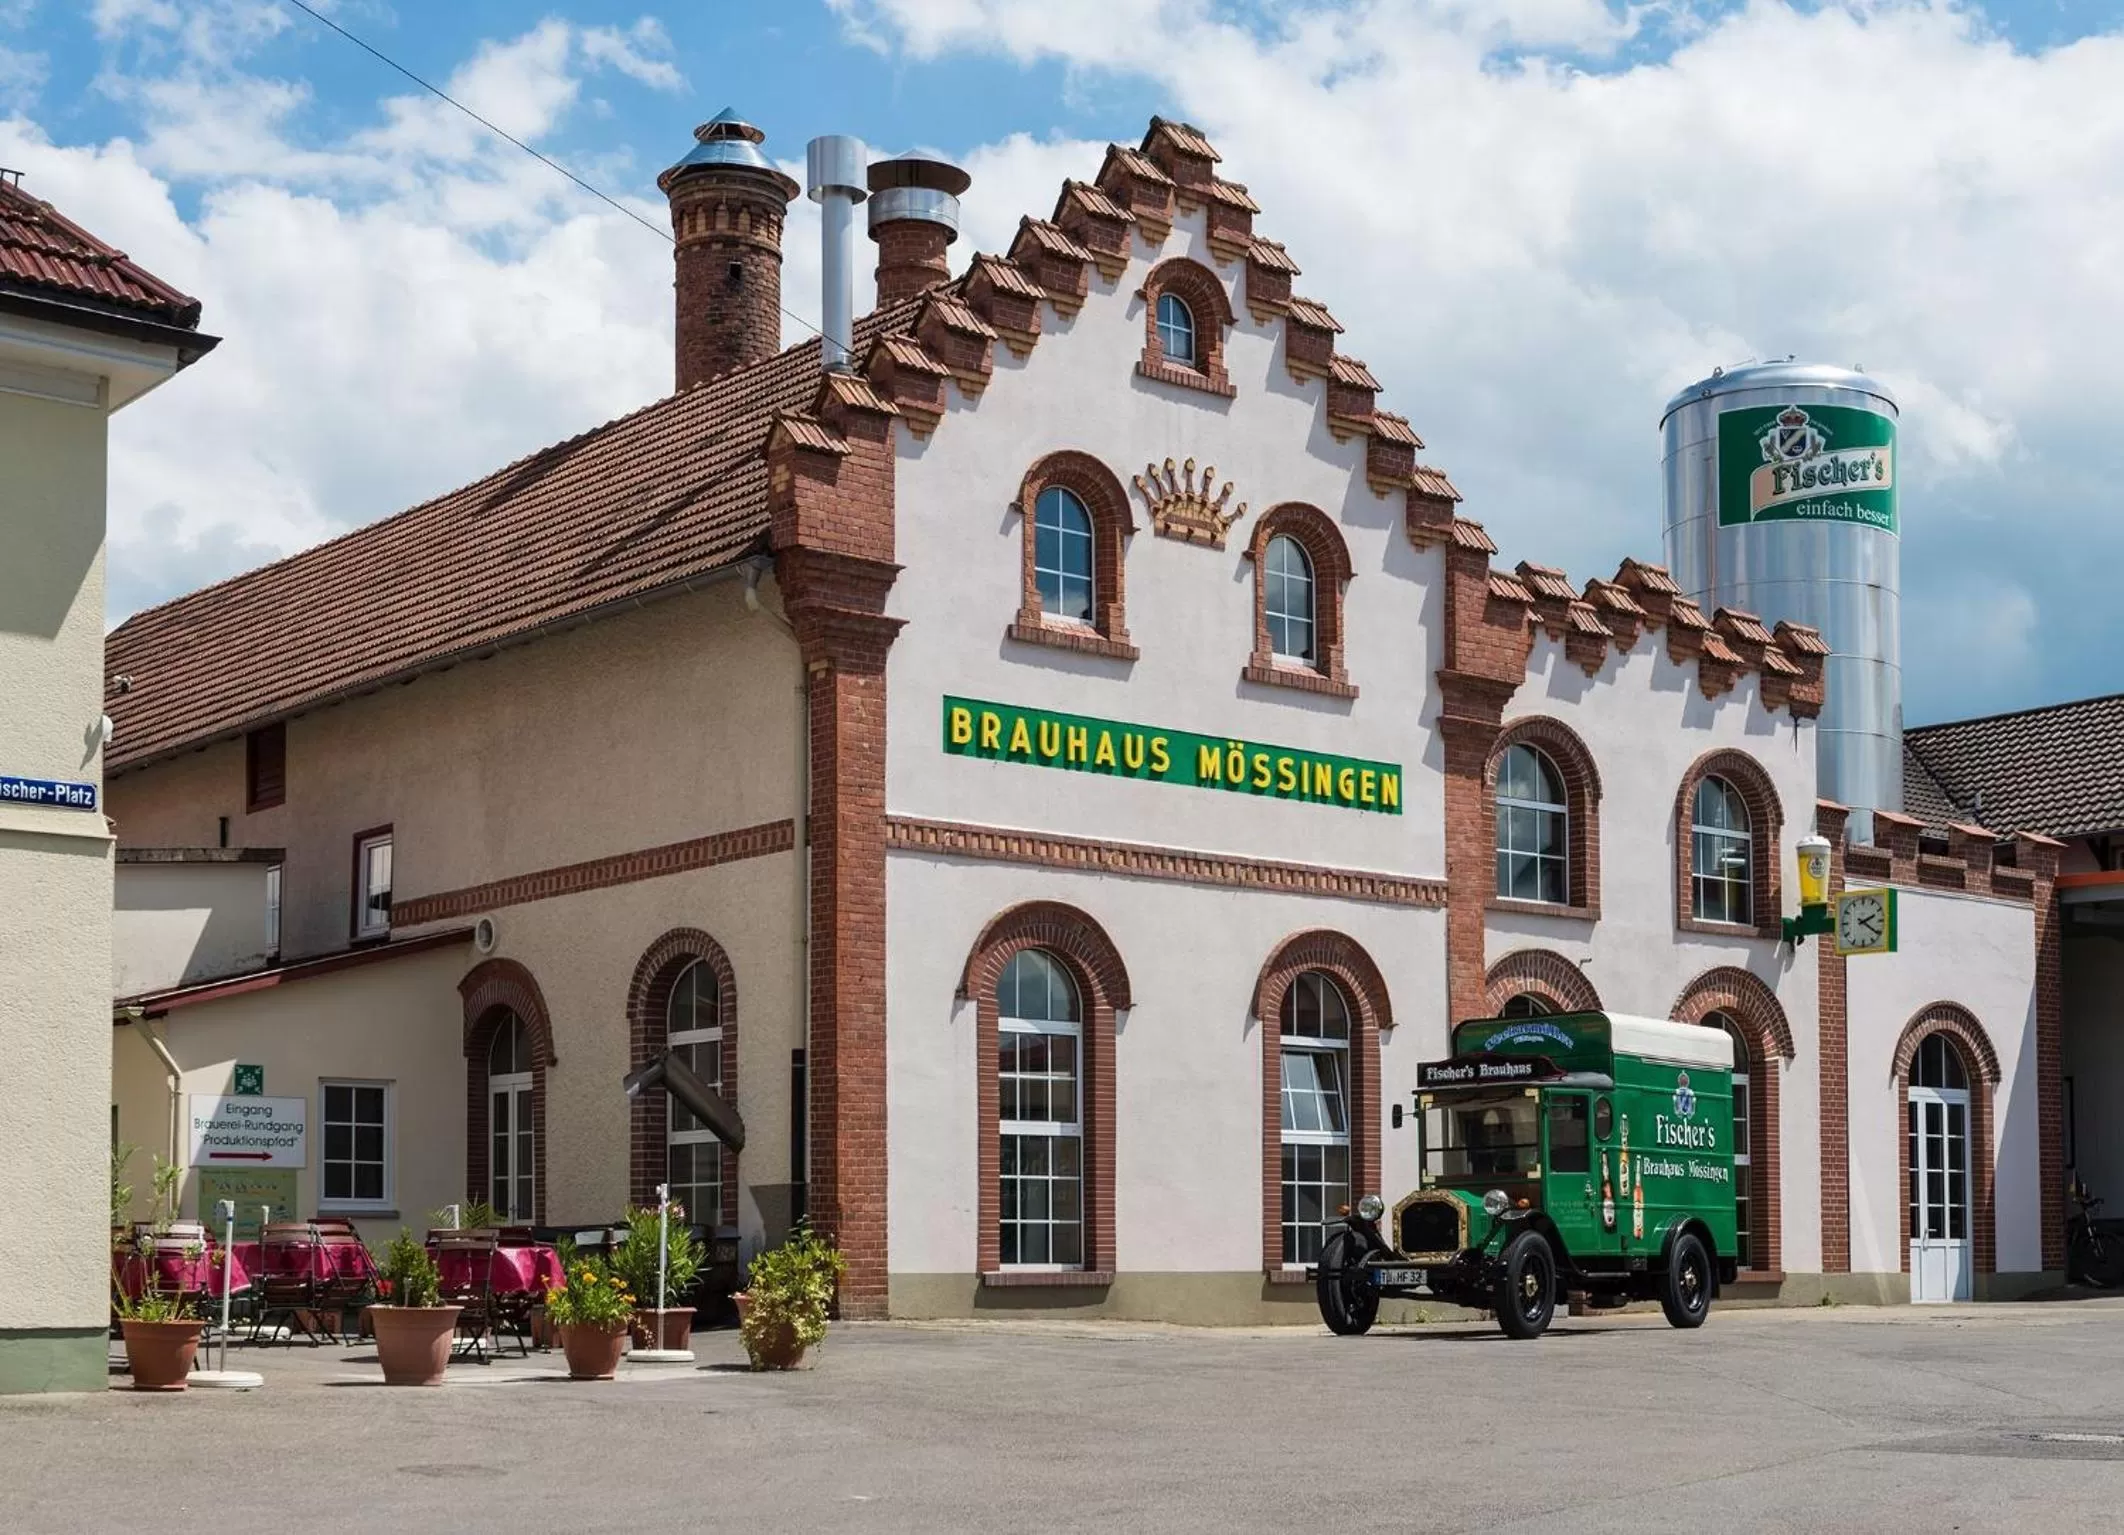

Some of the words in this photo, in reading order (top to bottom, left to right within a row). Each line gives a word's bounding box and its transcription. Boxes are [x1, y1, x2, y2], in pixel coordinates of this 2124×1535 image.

[1772, 451, 1884, 496] Fischer's
[1796, 499, 1853, 517] einfach
[949, 706, 1170, 773] BRAUHAUS
[1200, 741, 1398, 807] MÖSSINGEN
[1425, 1064, 1475, 1081] Fischer's
[1479, 1062, 1533, 1077] Brauhaus
[226, 1103, 273, 1118] Eingang
[194, 1118, 304, 1135] Brauerei-Rundgang
[1656, 1114, 1715, 1149] Fischer's
[1643, 1157, 1685, 1179] Brauhaus
